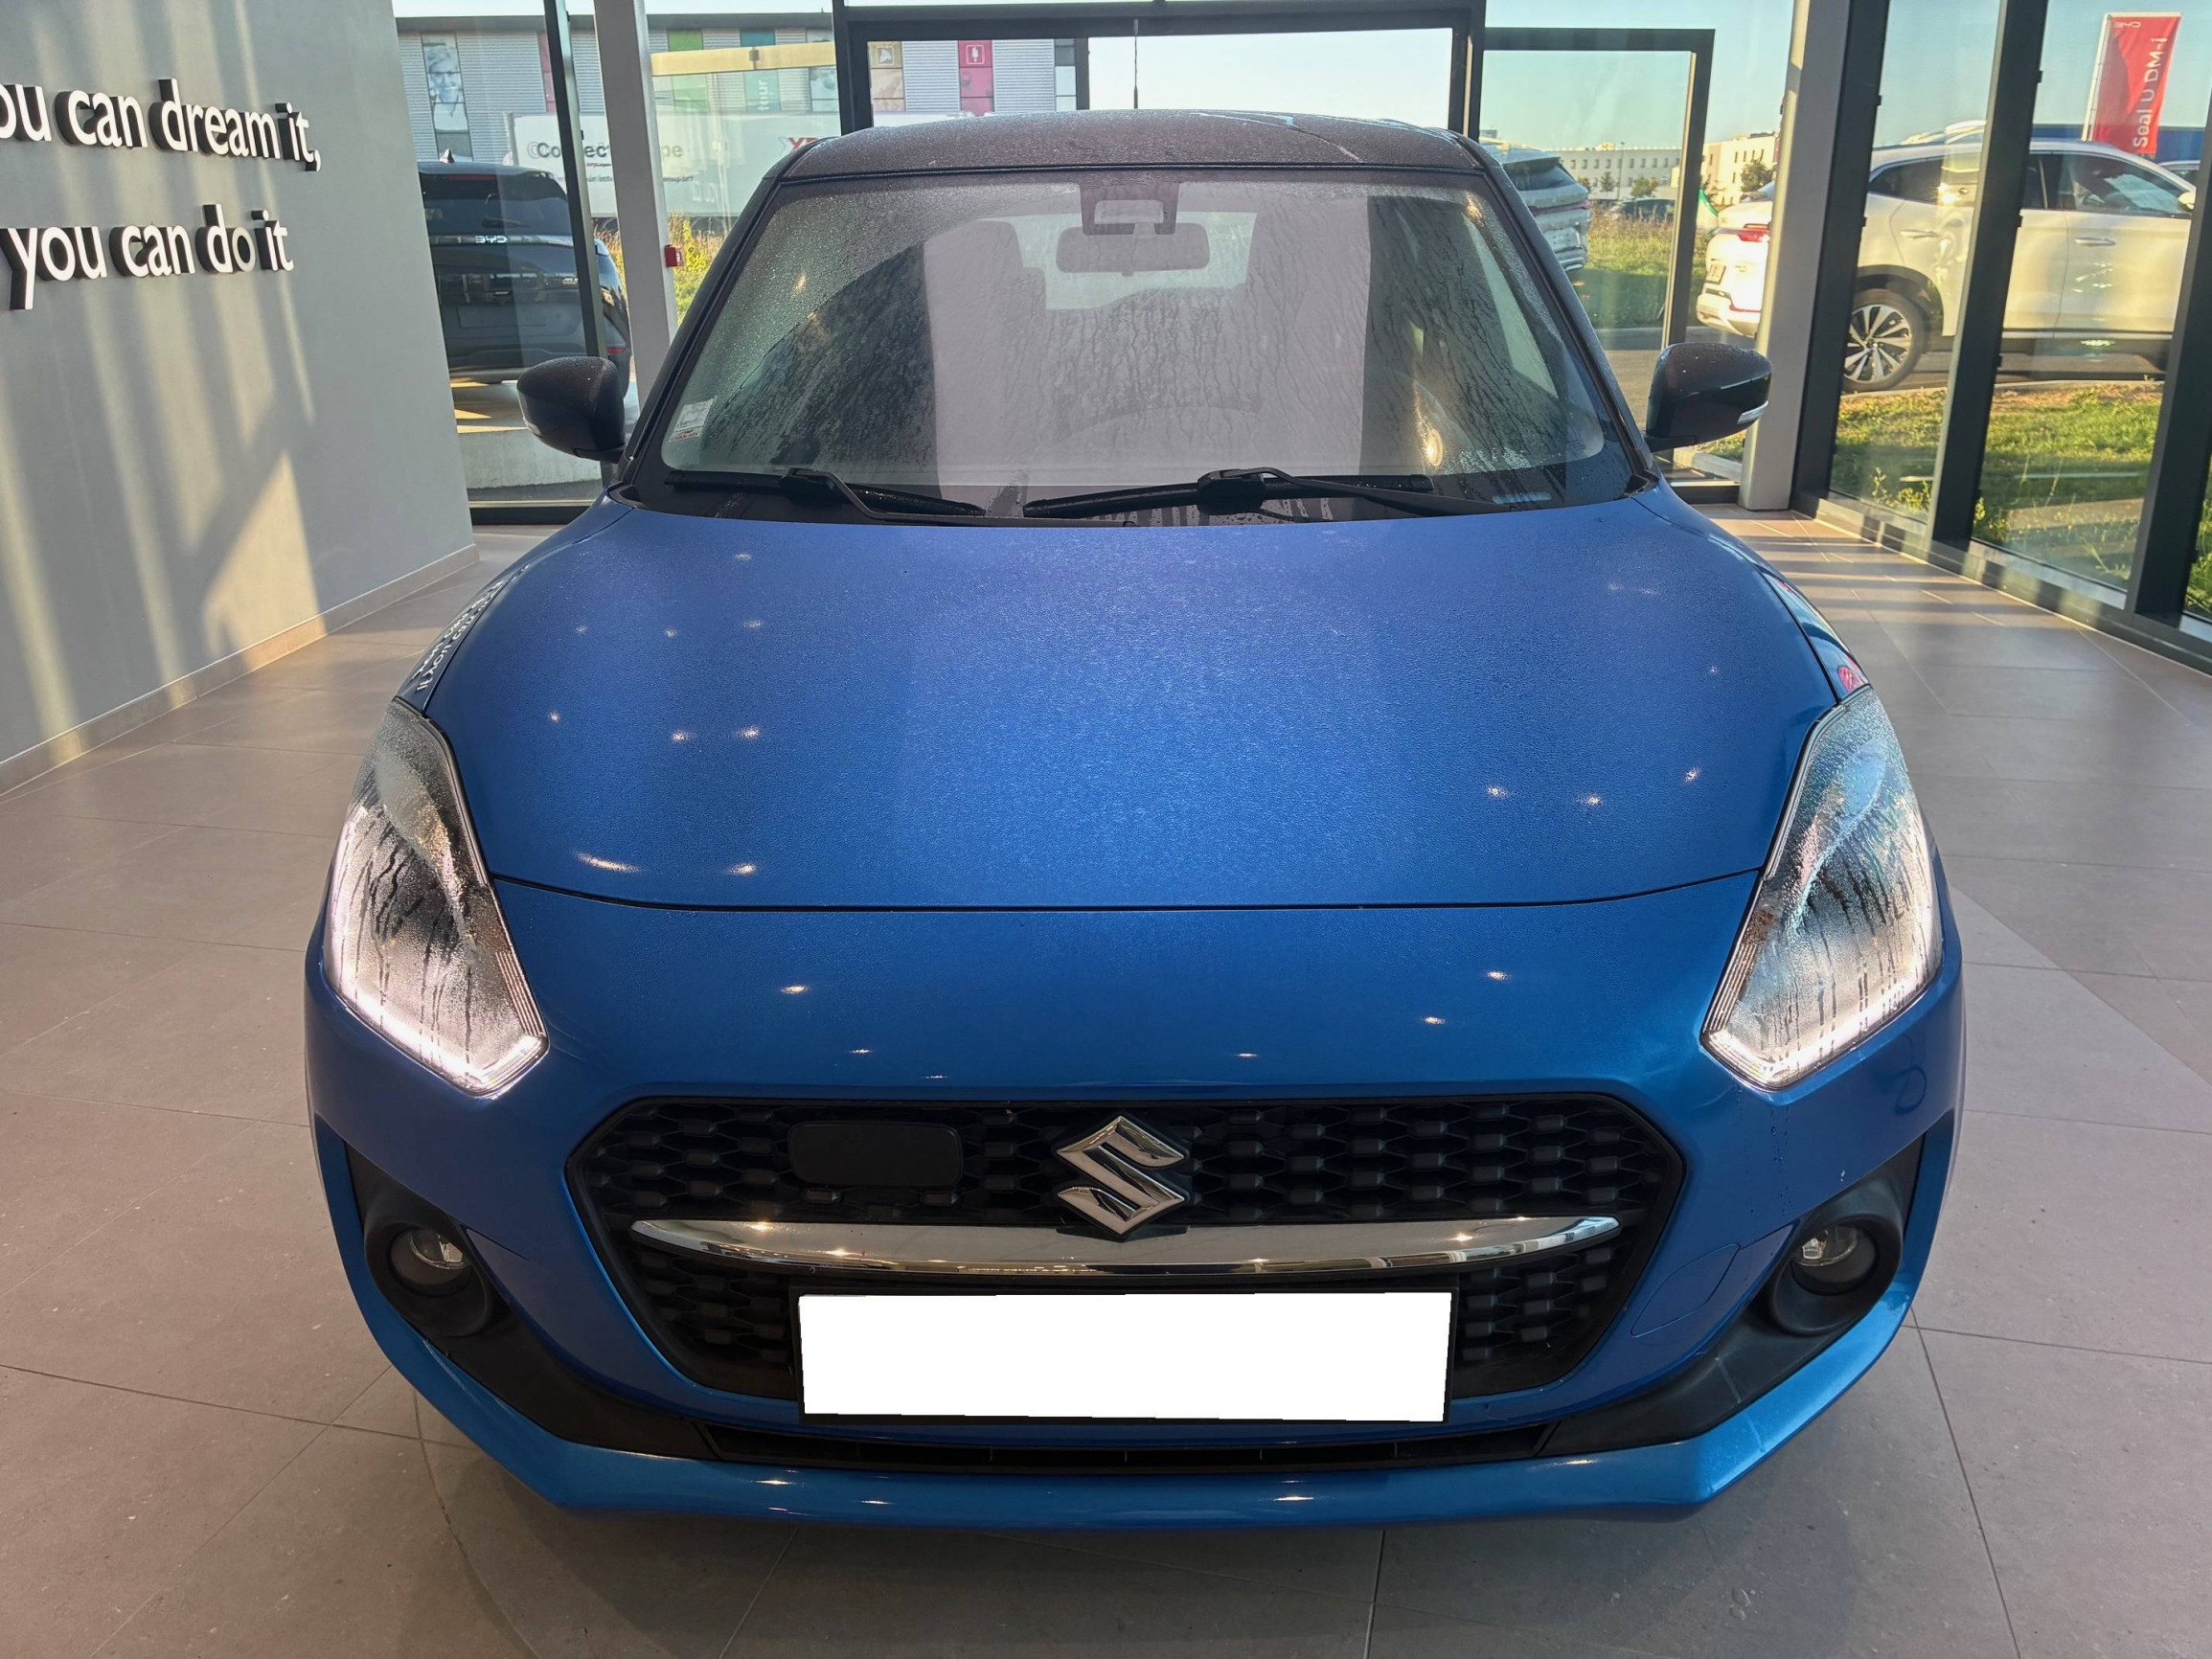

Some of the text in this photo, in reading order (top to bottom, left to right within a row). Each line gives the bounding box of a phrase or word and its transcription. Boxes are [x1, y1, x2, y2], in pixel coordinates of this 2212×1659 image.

[67, 89, 148, 148] can
[161, 78, 282, 160] dream
[285, 102, 322, 171] it,
[2132, 37, 2168, 148] Seal U DM-i
[7, 203, 294, 310] you can do it
